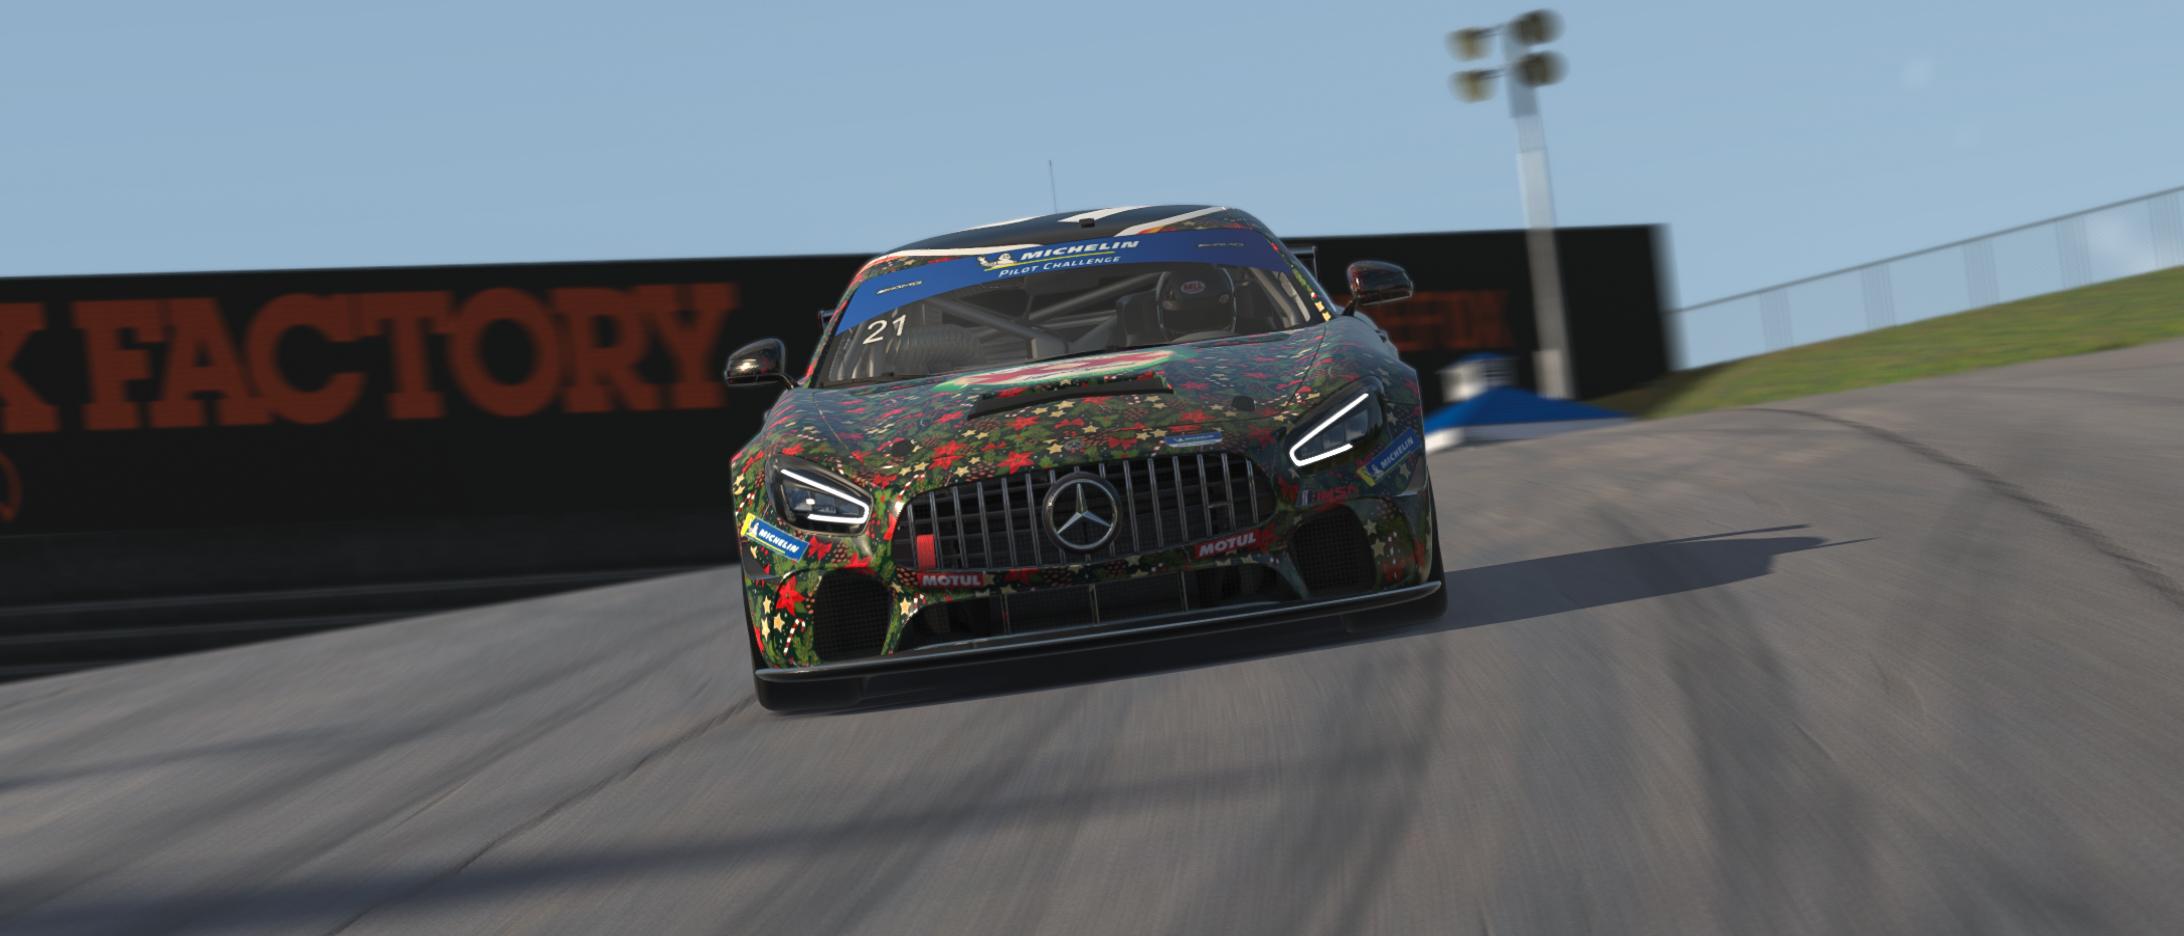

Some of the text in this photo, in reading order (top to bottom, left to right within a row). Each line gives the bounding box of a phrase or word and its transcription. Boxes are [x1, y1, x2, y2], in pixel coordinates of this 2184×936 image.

[1020, 240, 1140, 261] MICHELIN
[998, 256, 1121, 278] PILOT CHALLENGE
[862, 314, 906, 345] 21
[71, 282, 740, 431] FACTORY
[1380, 436, 1414, 470] MICHELIN
[758, 528, 800, 553] MICHELIN
[1199, 532, 1256, 557] MOTUL
[922, 574, 980, 587] MOTUL
